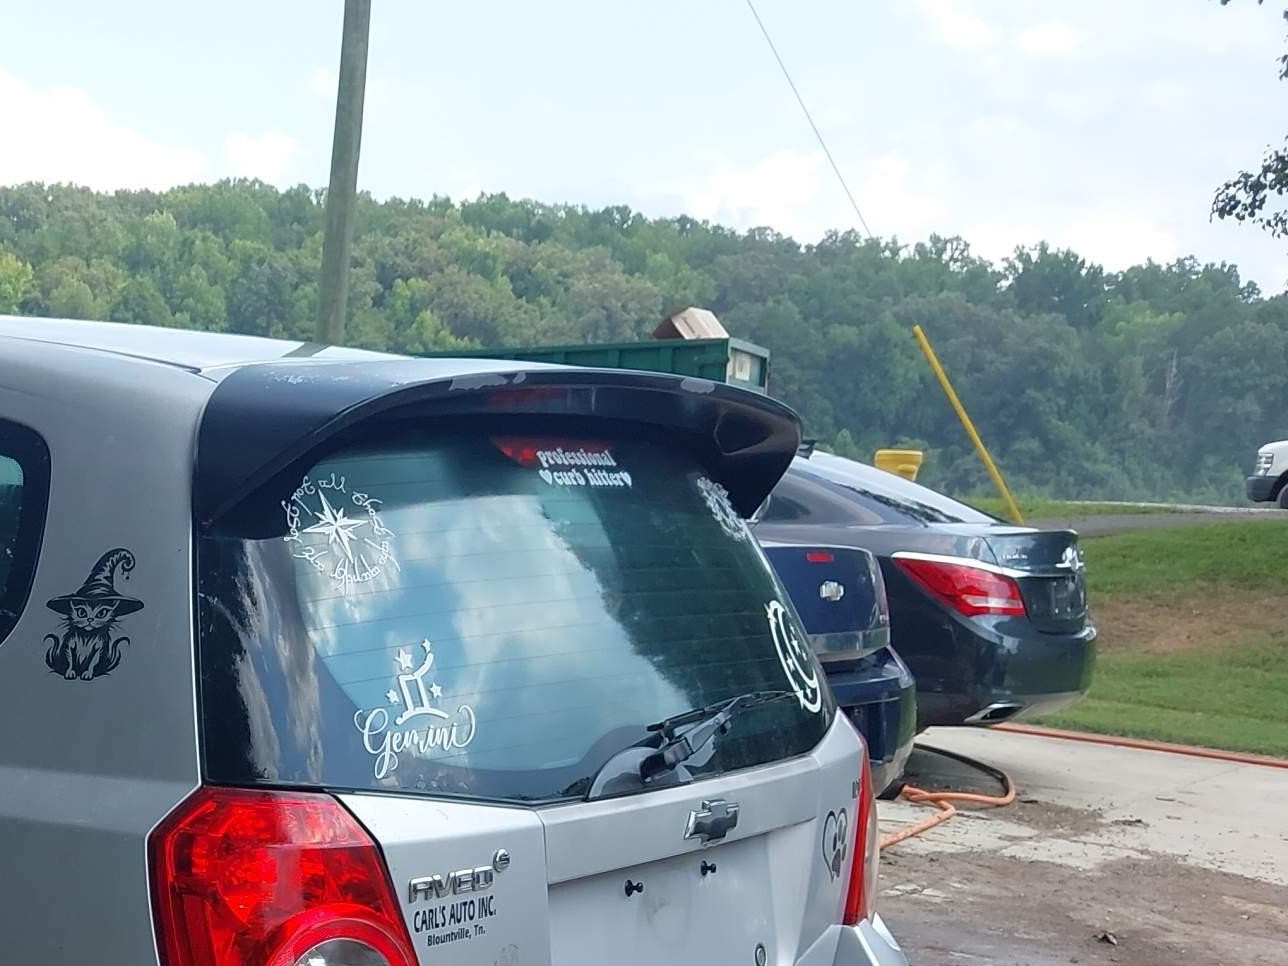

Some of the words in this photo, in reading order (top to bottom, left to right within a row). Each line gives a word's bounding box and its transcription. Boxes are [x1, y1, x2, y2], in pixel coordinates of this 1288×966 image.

[535, 448, 617, 468] professional
[552, 468, 586, 486] curb
[354, 705, 476, 779] Gemini
[413, 905, 447, 933] CARL'S
[448, 900, 476, 926] AUTO
[477, 895, 497, 920] INC.
[427, 927, 472, 947] Blountville,
